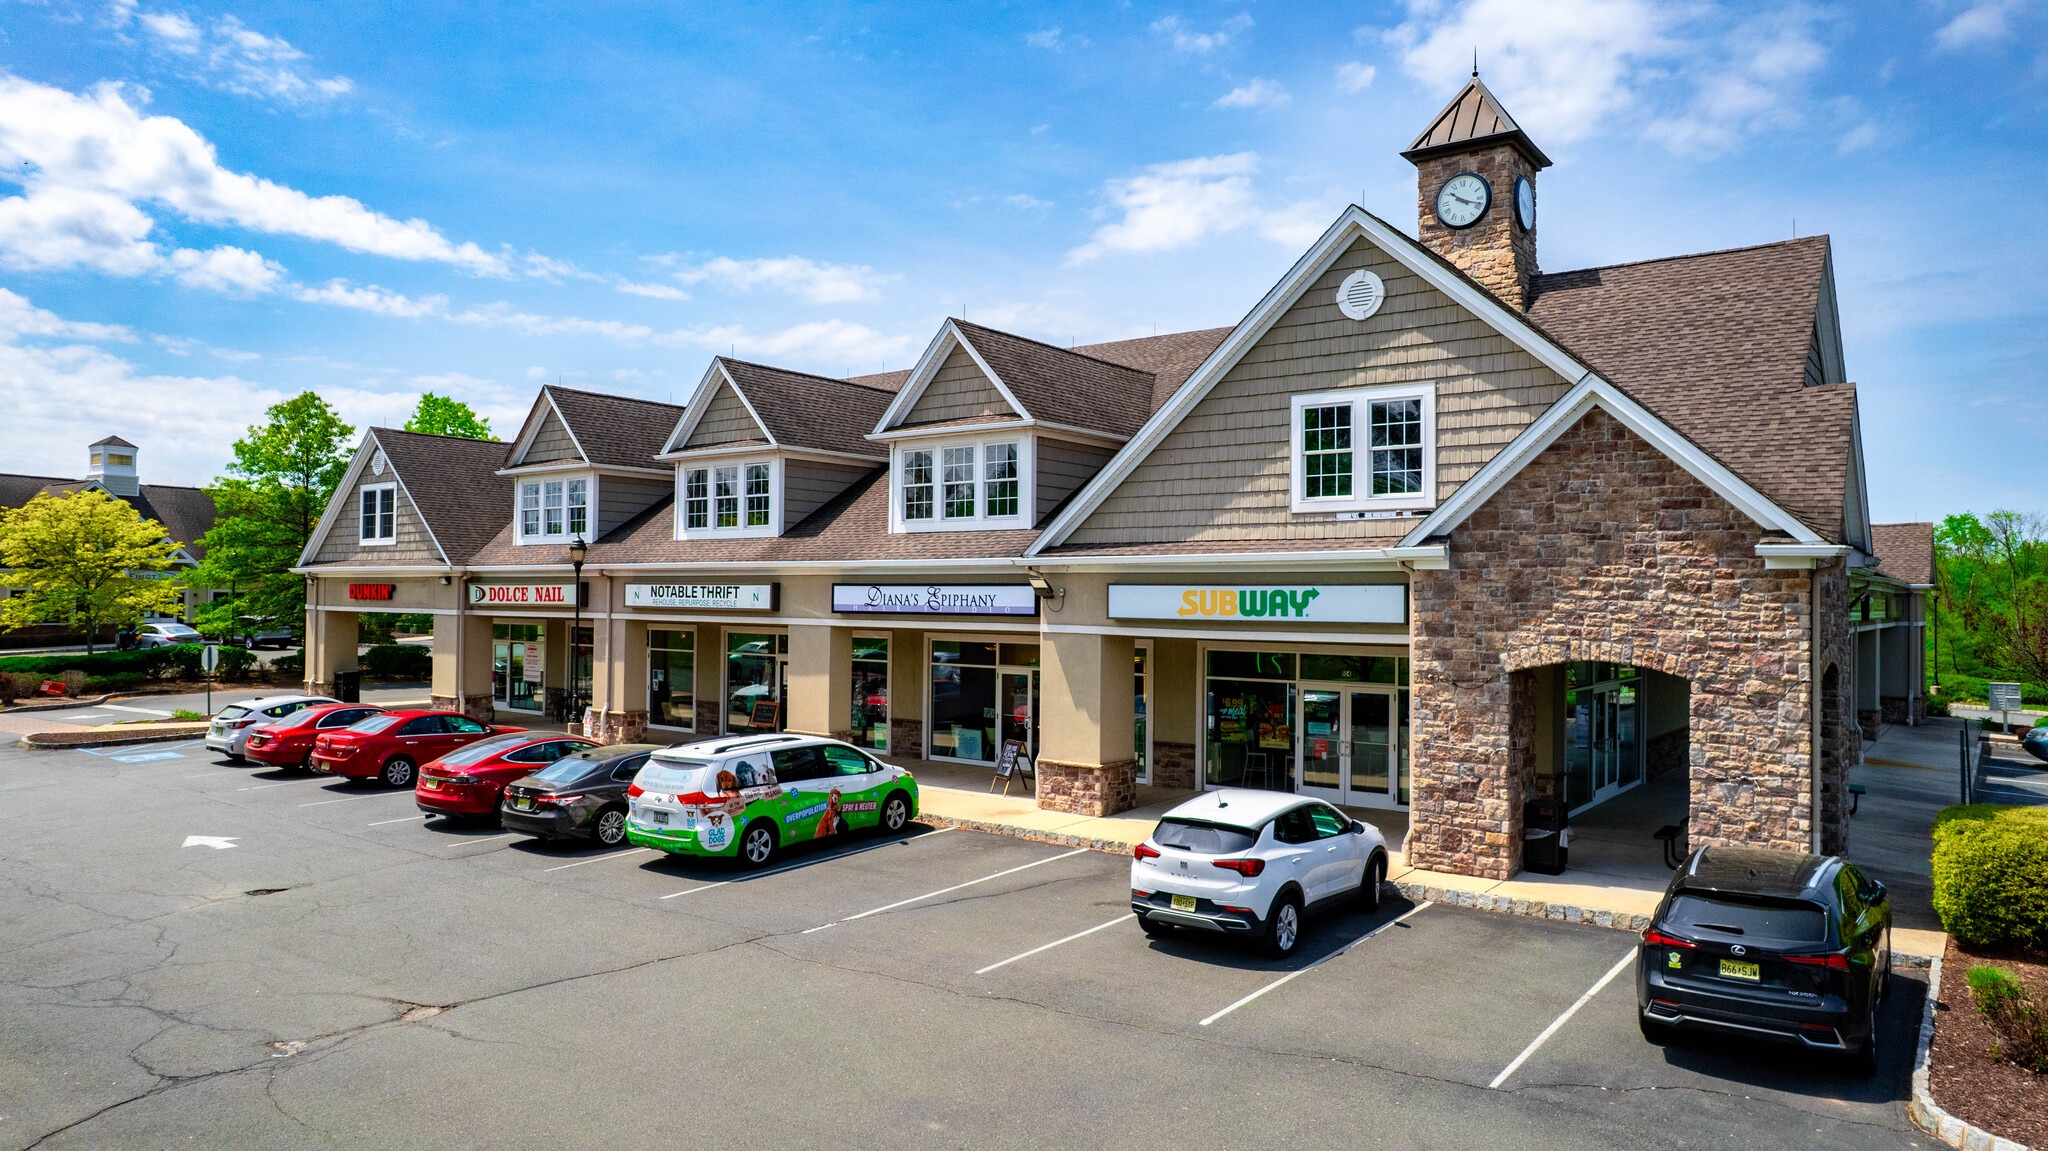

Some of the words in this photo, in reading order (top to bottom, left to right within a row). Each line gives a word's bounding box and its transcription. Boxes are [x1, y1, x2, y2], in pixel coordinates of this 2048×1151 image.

[349, 583, 392, 601] DUNKIN'
[488, 587, 529, 602] DOLCE
[535, 587, 565, 602] NAIL
[650, 585, 698, 599] NOTABLE
[700, 586, 740, 599] THRIFT
[926, 586, 997, 611] EPIPHANY
[853, 605, 902, 613] HAIR
[924, 606, 1011, 614] STUDIO
[1177, 587, 1320, 618] SUBWAY
[786, 802, 827, 823] OVERPOPULATION
[842, 803, 854, 812] SPAY
[855, 803, 860, 811] &
[860, 802, 877, 811] NEUTER
[708, 827, 725, 837] GLAD
[708, 834, 725, 844] DOGS
